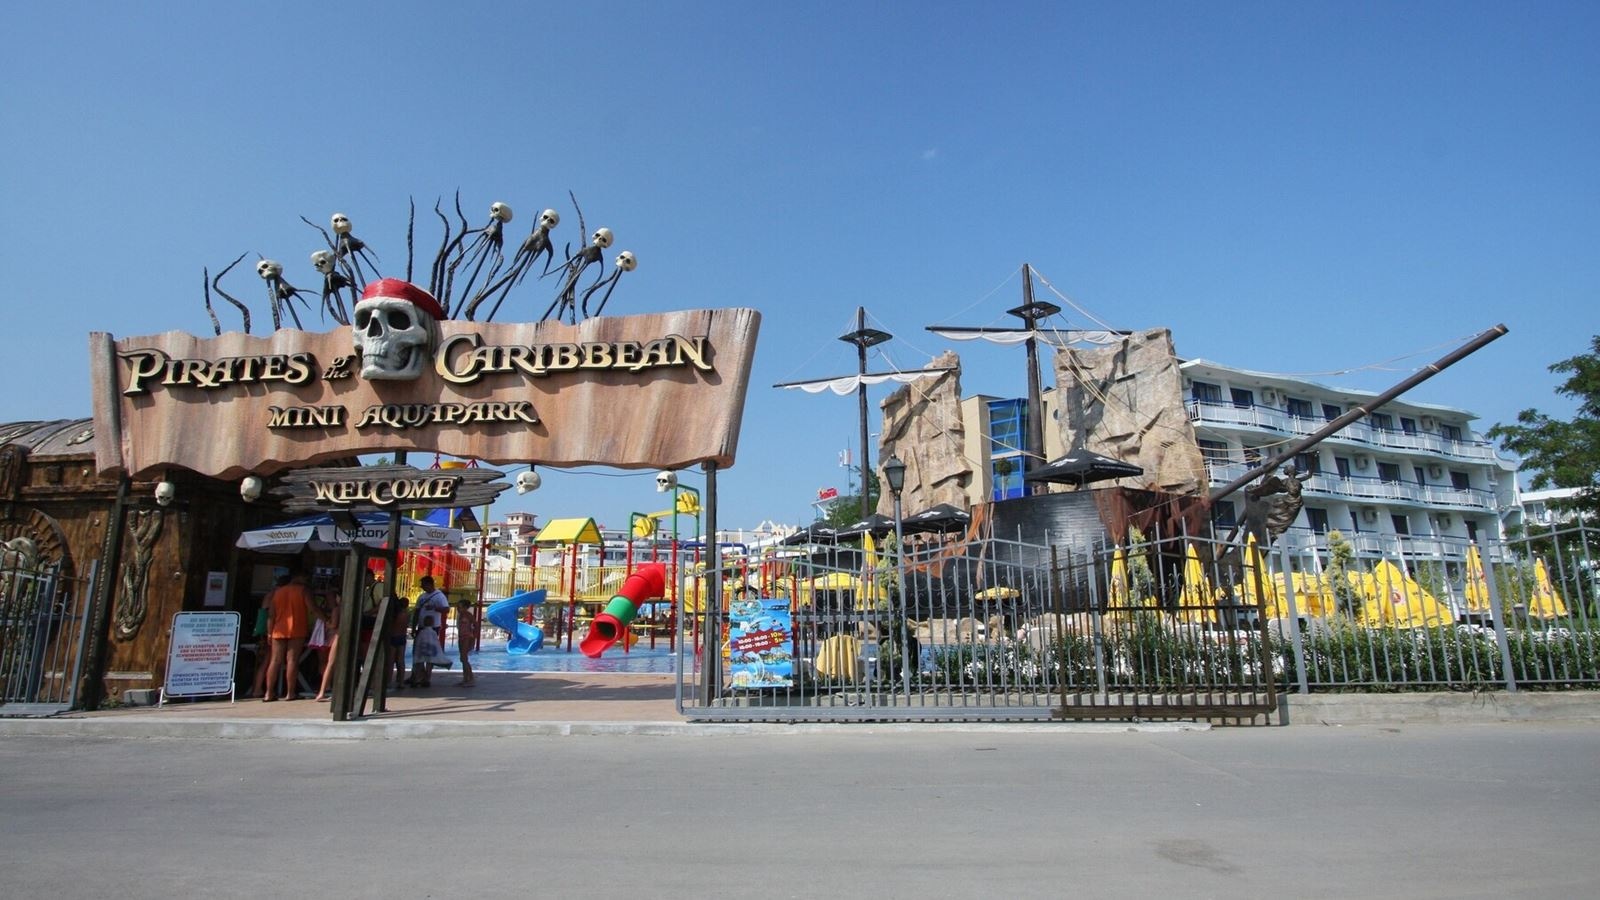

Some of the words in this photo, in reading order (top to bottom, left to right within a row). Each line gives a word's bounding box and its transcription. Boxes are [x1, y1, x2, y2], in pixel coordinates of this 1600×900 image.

[118, 348, 314, 396] PIRATES
[321, 366, 351, 380] the
[435, 333, 713, 384] CARIBBEAN
[267, 405, 344, 428] MINI
[355, 401, 538, 428] AQUAPARK
[309, 475, 459, 505] WELCOME
